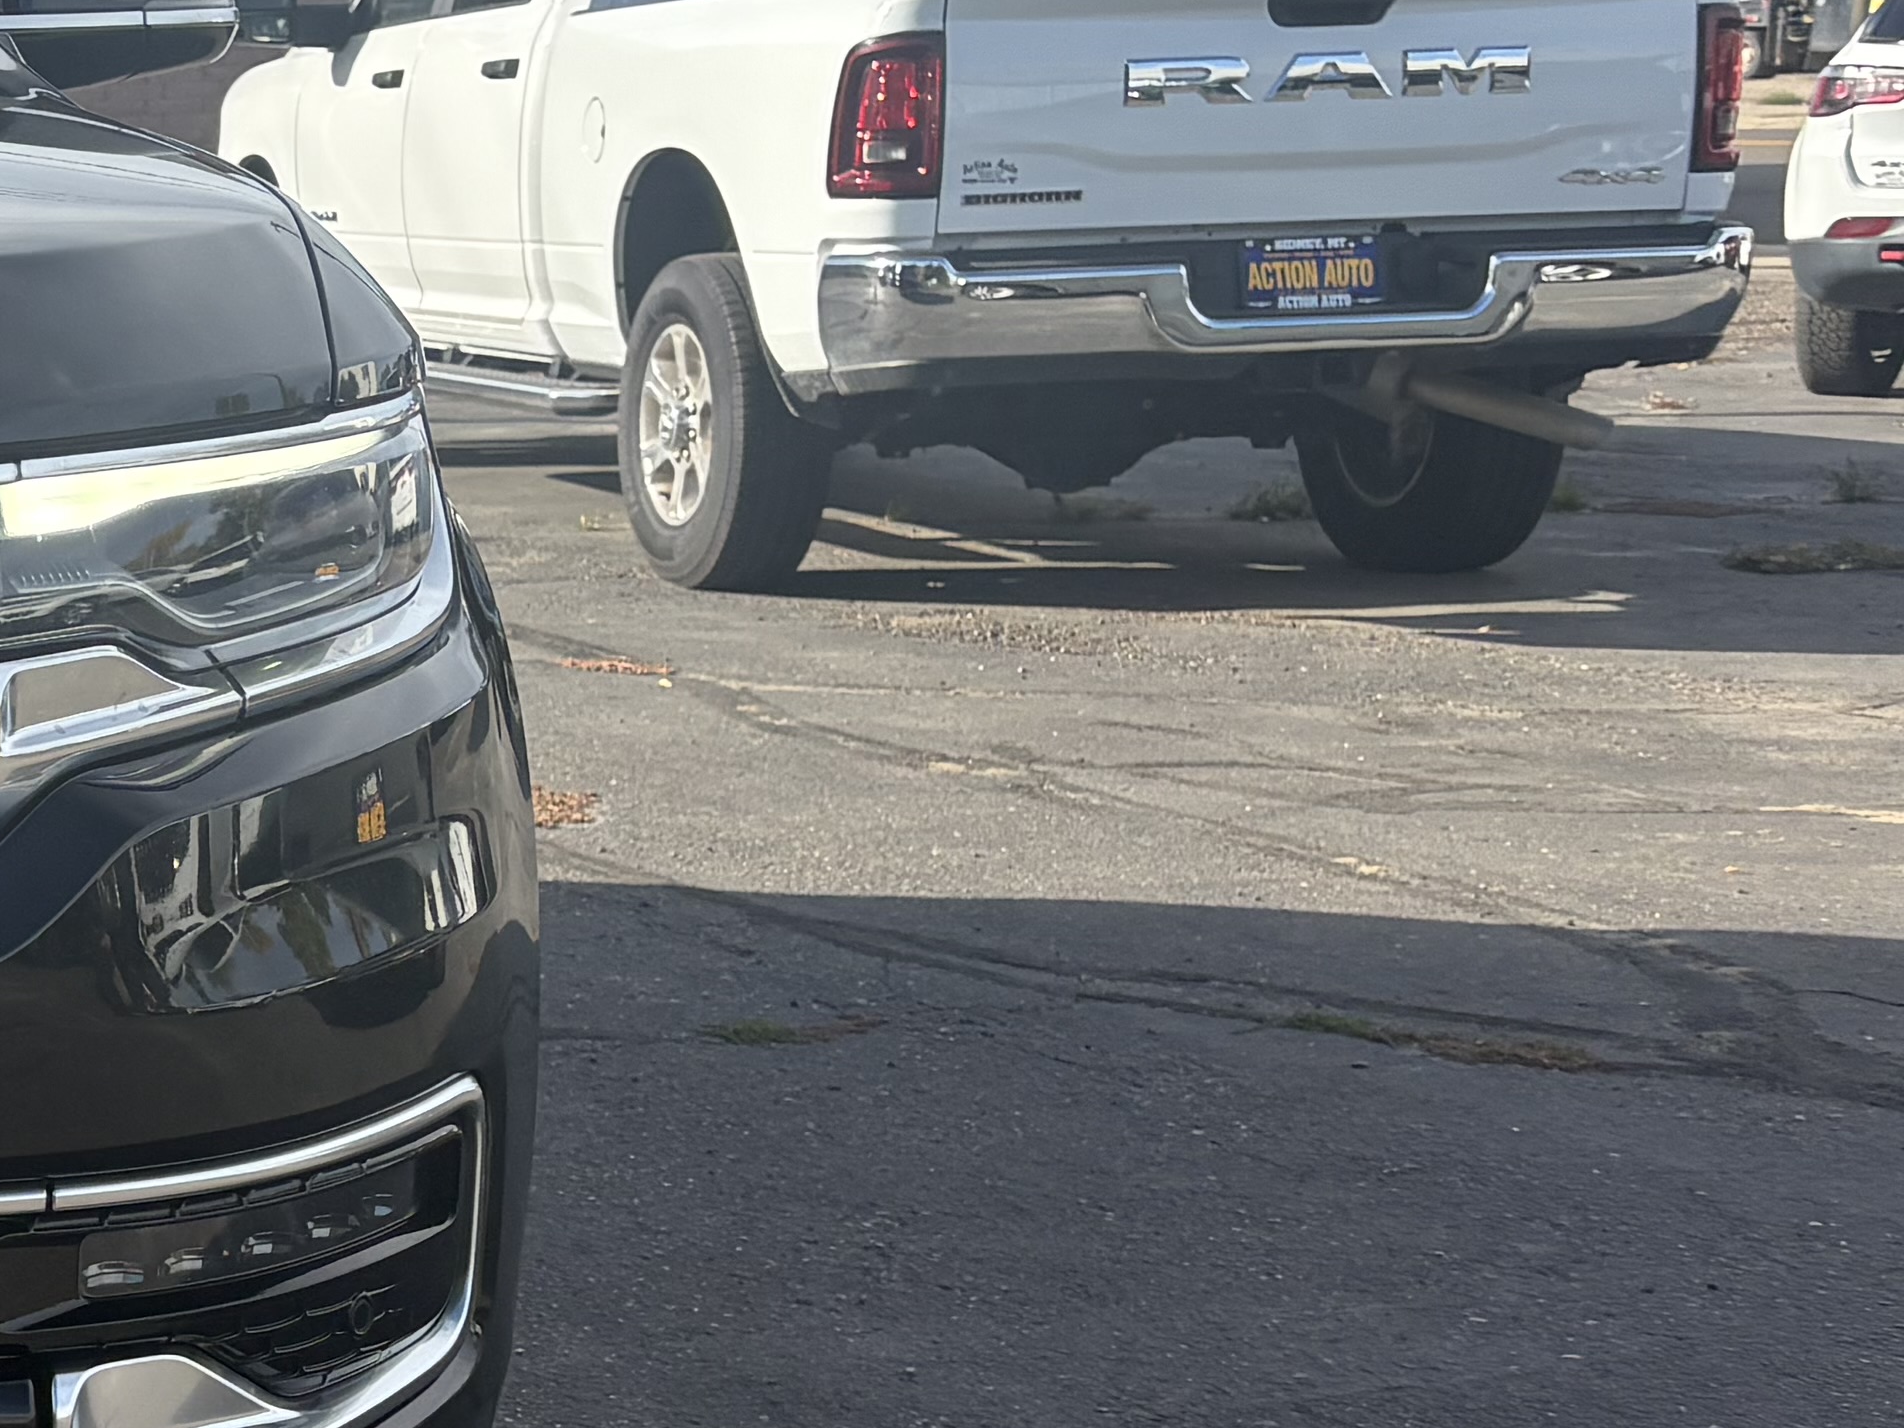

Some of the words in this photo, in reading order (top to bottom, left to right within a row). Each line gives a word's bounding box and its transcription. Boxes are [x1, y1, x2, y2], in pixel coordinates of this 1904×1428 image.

[1124, 45, 1531, 107] RAM
[1248, 259, 1319, 291] ACTION
[1324, 258, 1374, 288] AUTO
[1278, 295, 1319, 309] ACTION
[1321, 294, 1352, 308] AUTO
